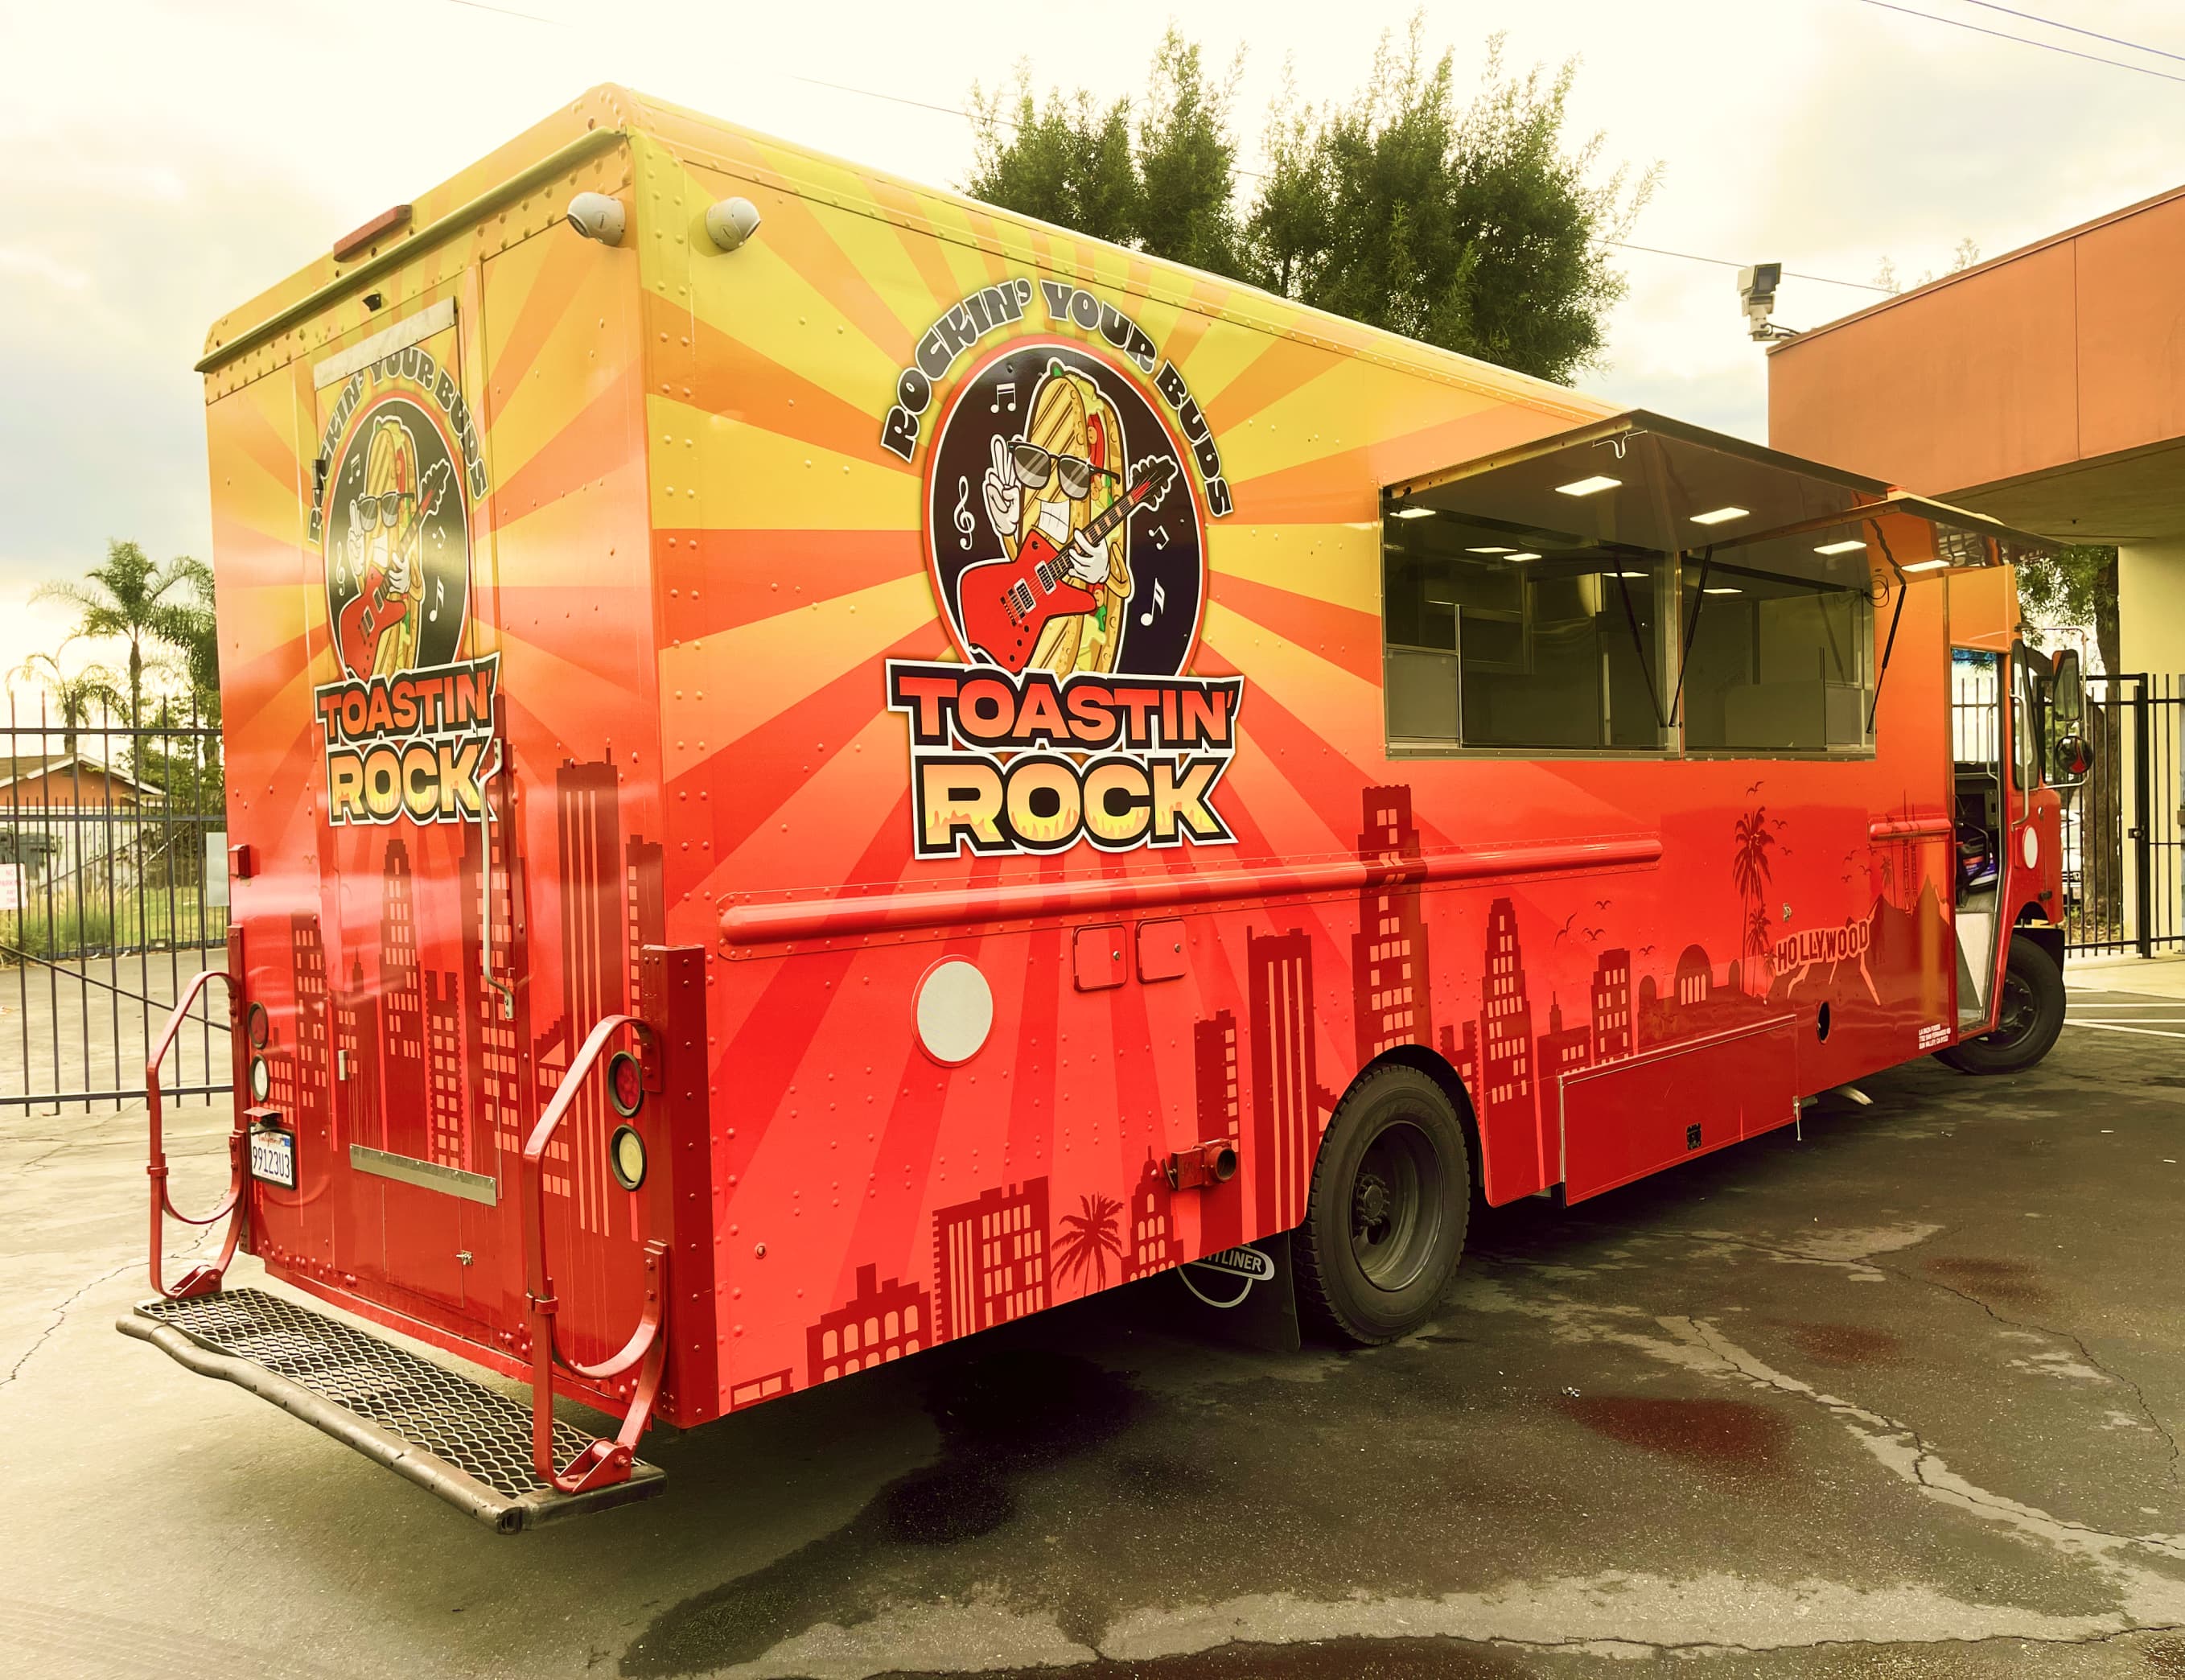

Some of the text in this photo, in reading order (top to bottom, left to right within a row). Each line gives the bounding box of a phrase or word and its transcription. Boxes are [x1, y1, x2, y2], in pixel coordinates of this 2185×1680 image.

[369, 346, 435, 389] YOUR
[433, 367, 488, 500] BUDS
[880, 278, 1234, 517] ROCKIN' YOUR BUDS
[318, 665, 494, 740] TOASTIN'
[895, 671, 1237, 744] TOASTIN'
[328, 741, 487, 818] ROCK
[919, 759, 1224, 849] ROCK
[1776, 919, 1870, 974] HOLLYWOOD
[253, 1146, 290, 1179] 99123U3
